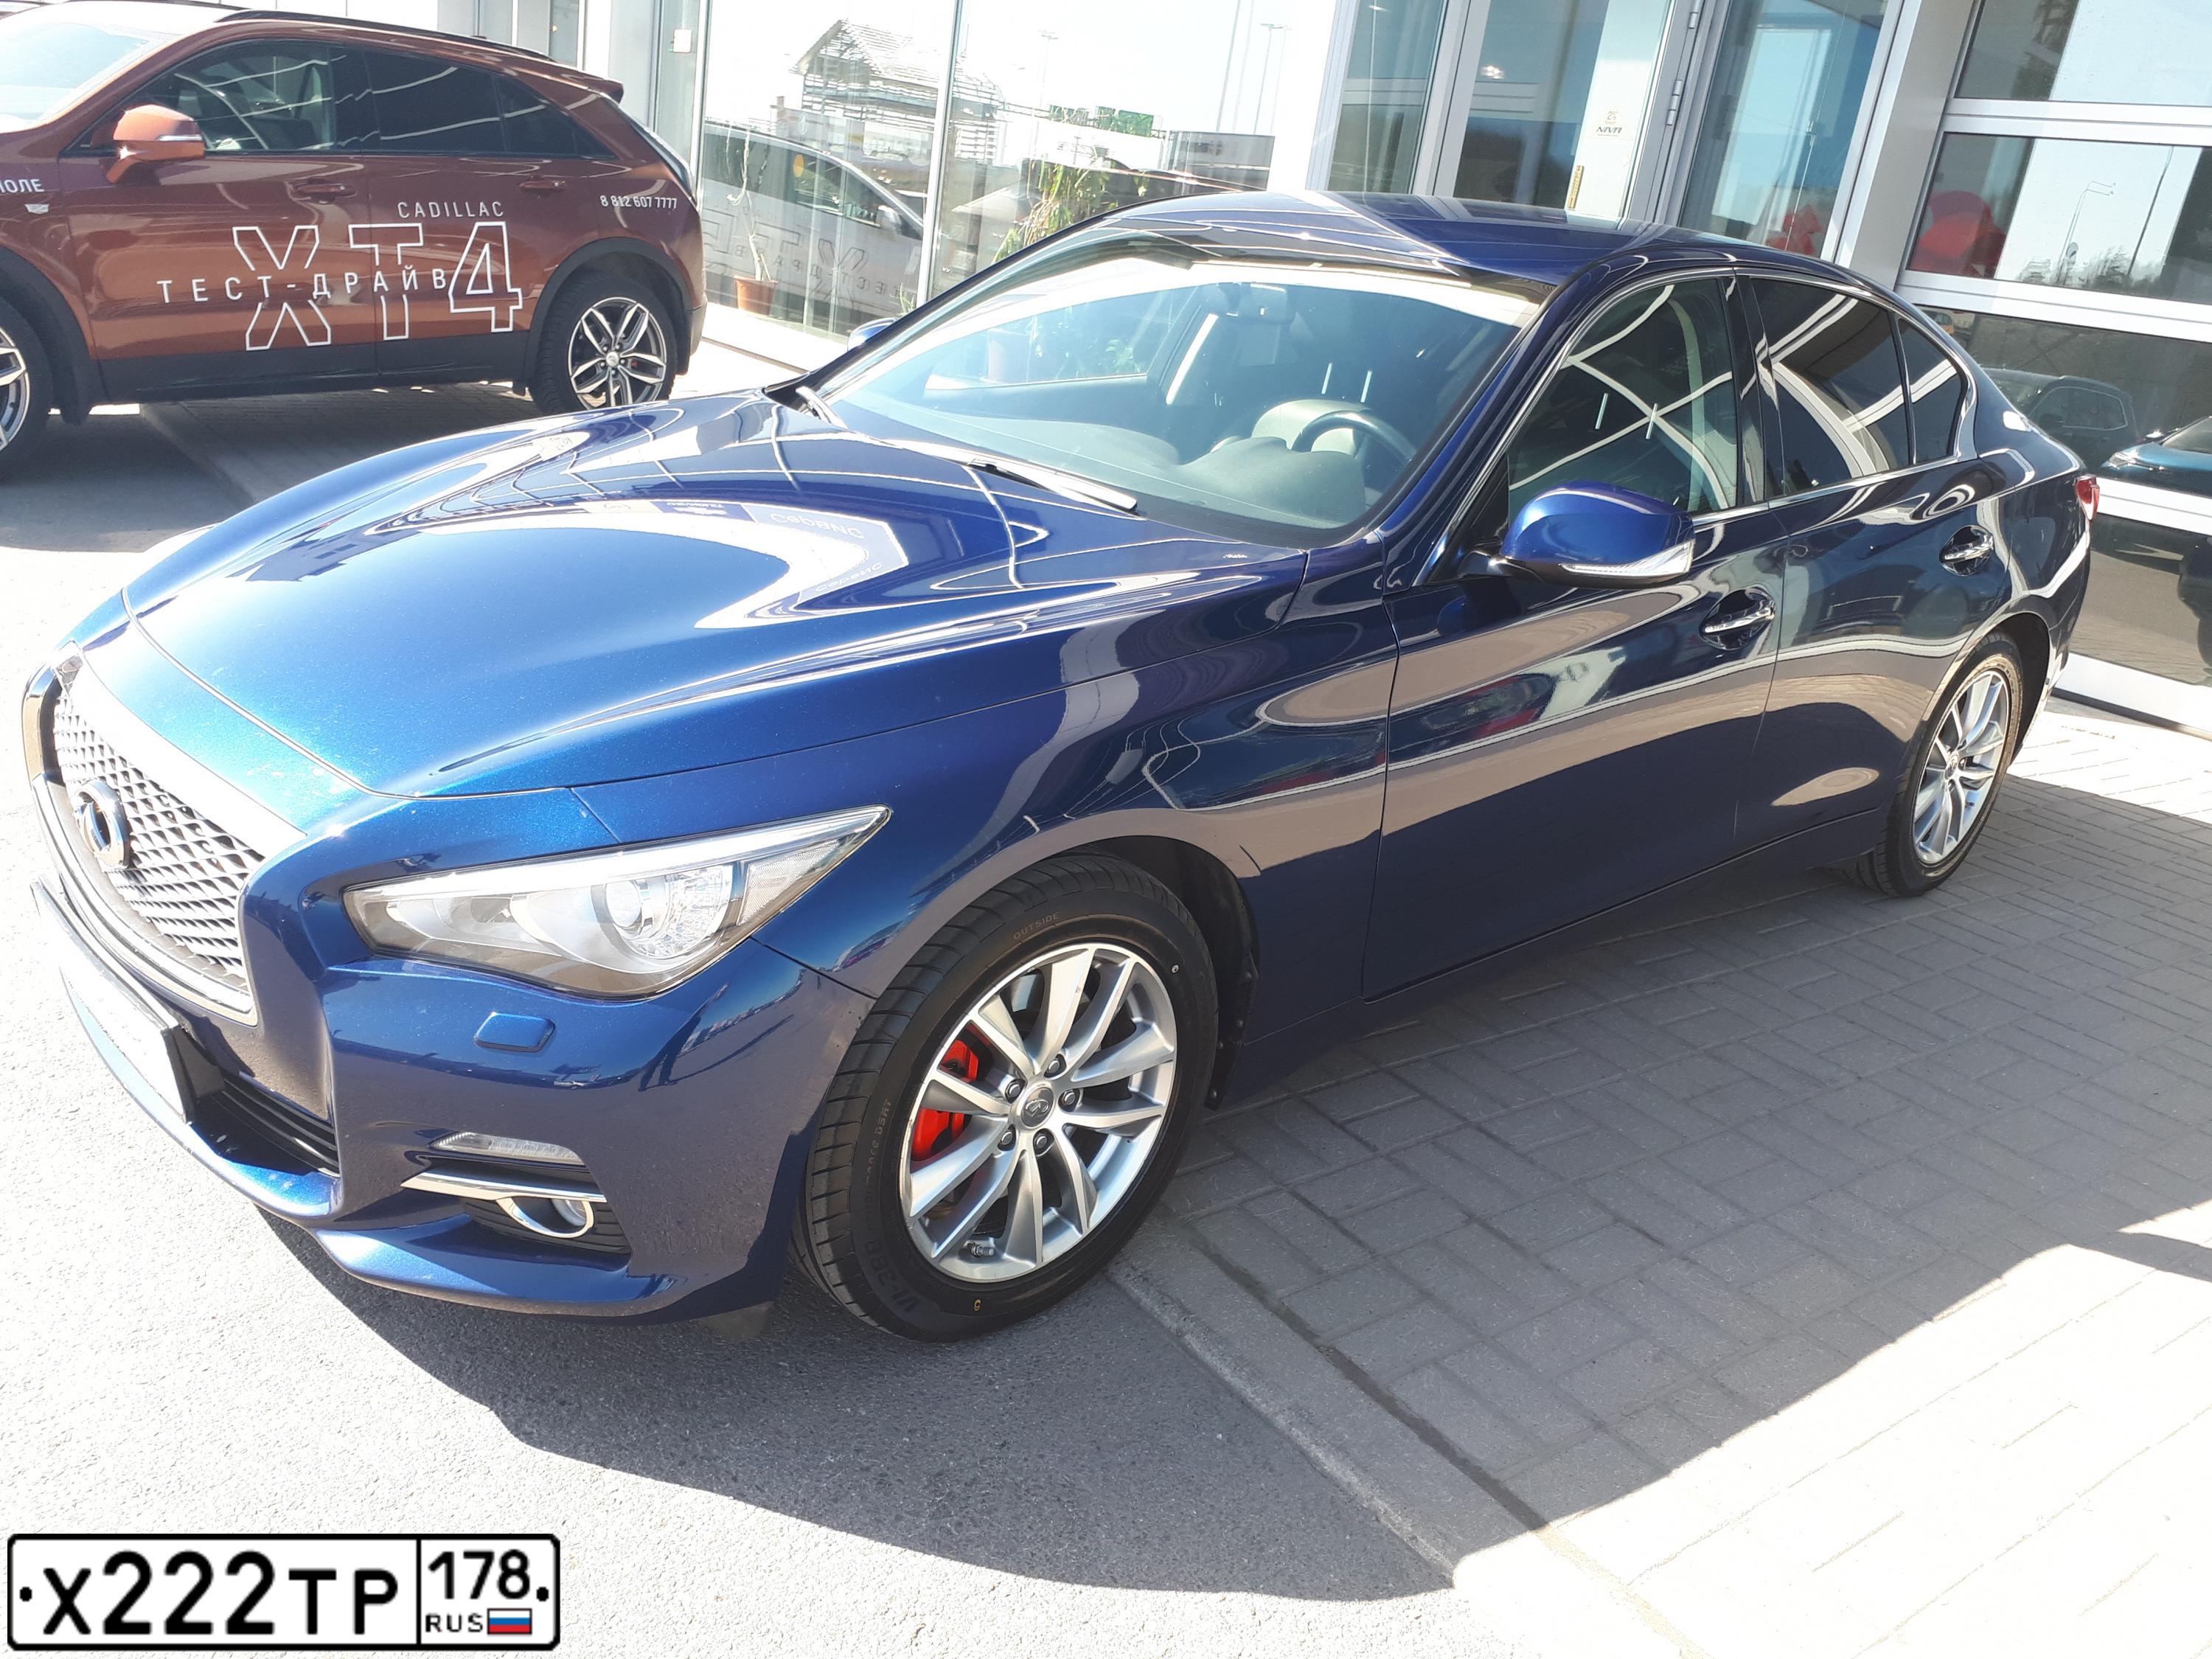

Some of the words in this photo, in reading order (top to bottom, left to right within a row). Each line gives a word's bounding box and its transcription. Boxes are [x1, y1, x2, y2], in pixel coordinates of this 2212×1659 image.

[397, 201, 504, 219] CADILLAC
[599, 195, 608, 206] 8
[611, 195, 631, 207] 812
[633, 196, 652, 208] 607
[654, 197, 677, 209] 7777
[156, 264, 448, 304] ТЕСТ-ДРАЙВ
[1013, 911, 1060, 940] OUTSIDE
